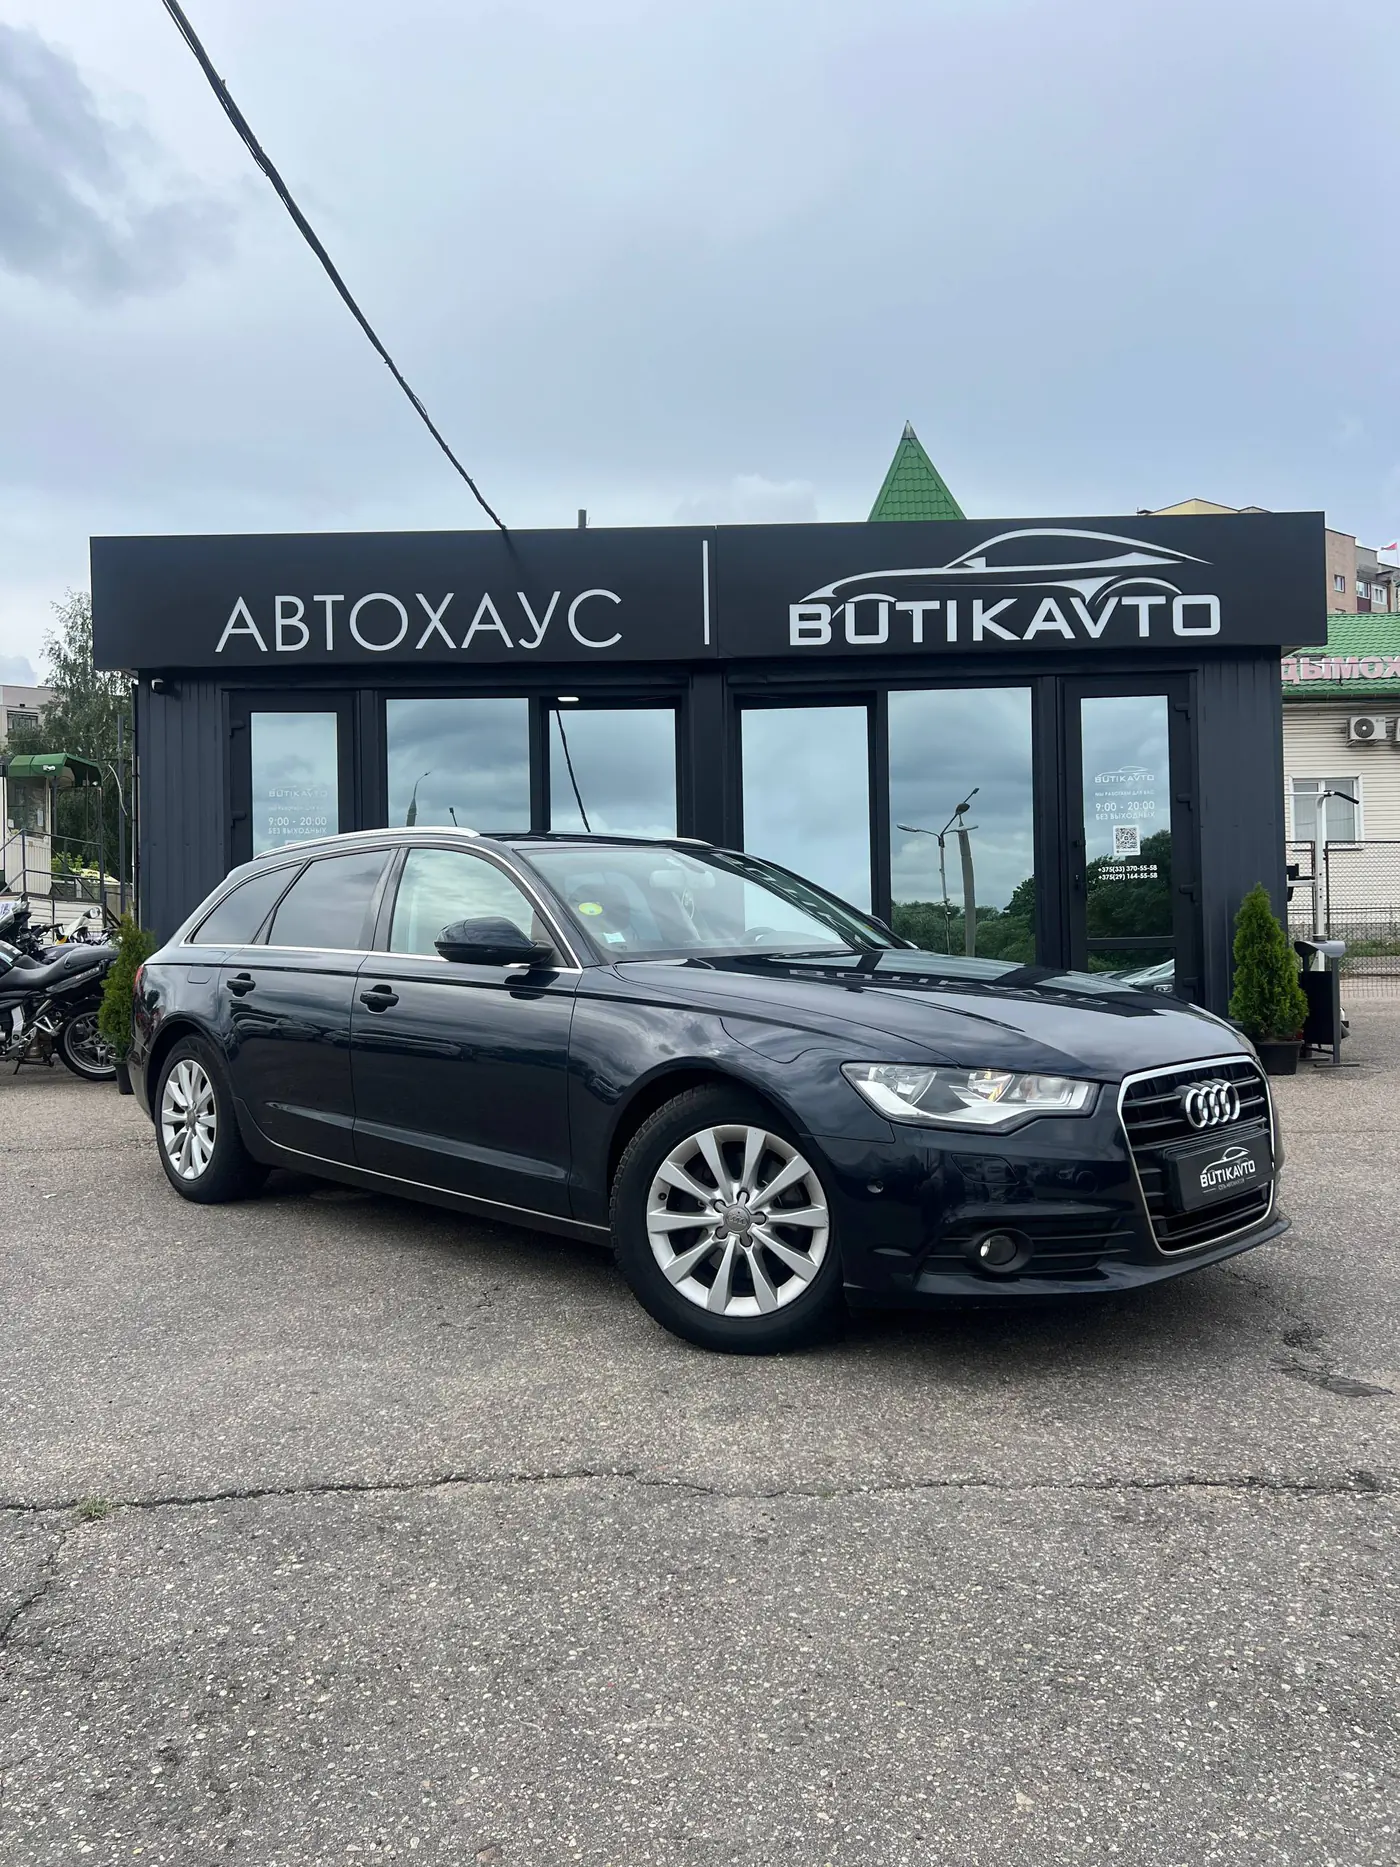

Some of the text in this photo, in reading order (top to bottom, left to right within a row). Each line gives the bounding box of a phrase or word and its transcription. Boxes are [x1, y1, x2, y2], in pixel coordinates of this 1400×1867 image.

[215, 588, 623, 652] АВТОХАУС
[788, 593, 1221, 646] BUTIKAVTO
[1094, 774, 1155, 783] BUTIKAVTO
[1095, 802, 1117, 812] 9:00
[1127, 800, 1155, 811] 20:00
[268, 816, 290, 826] 9:00
[299, 816, 327, 826] 20:00
[1098, 864, 1158, 873] +375(33) 370-55-58
[1098, 873, 1126, 881] +375(29)
[1199, 1159, 1256, 1188] BUTIKAVTO
